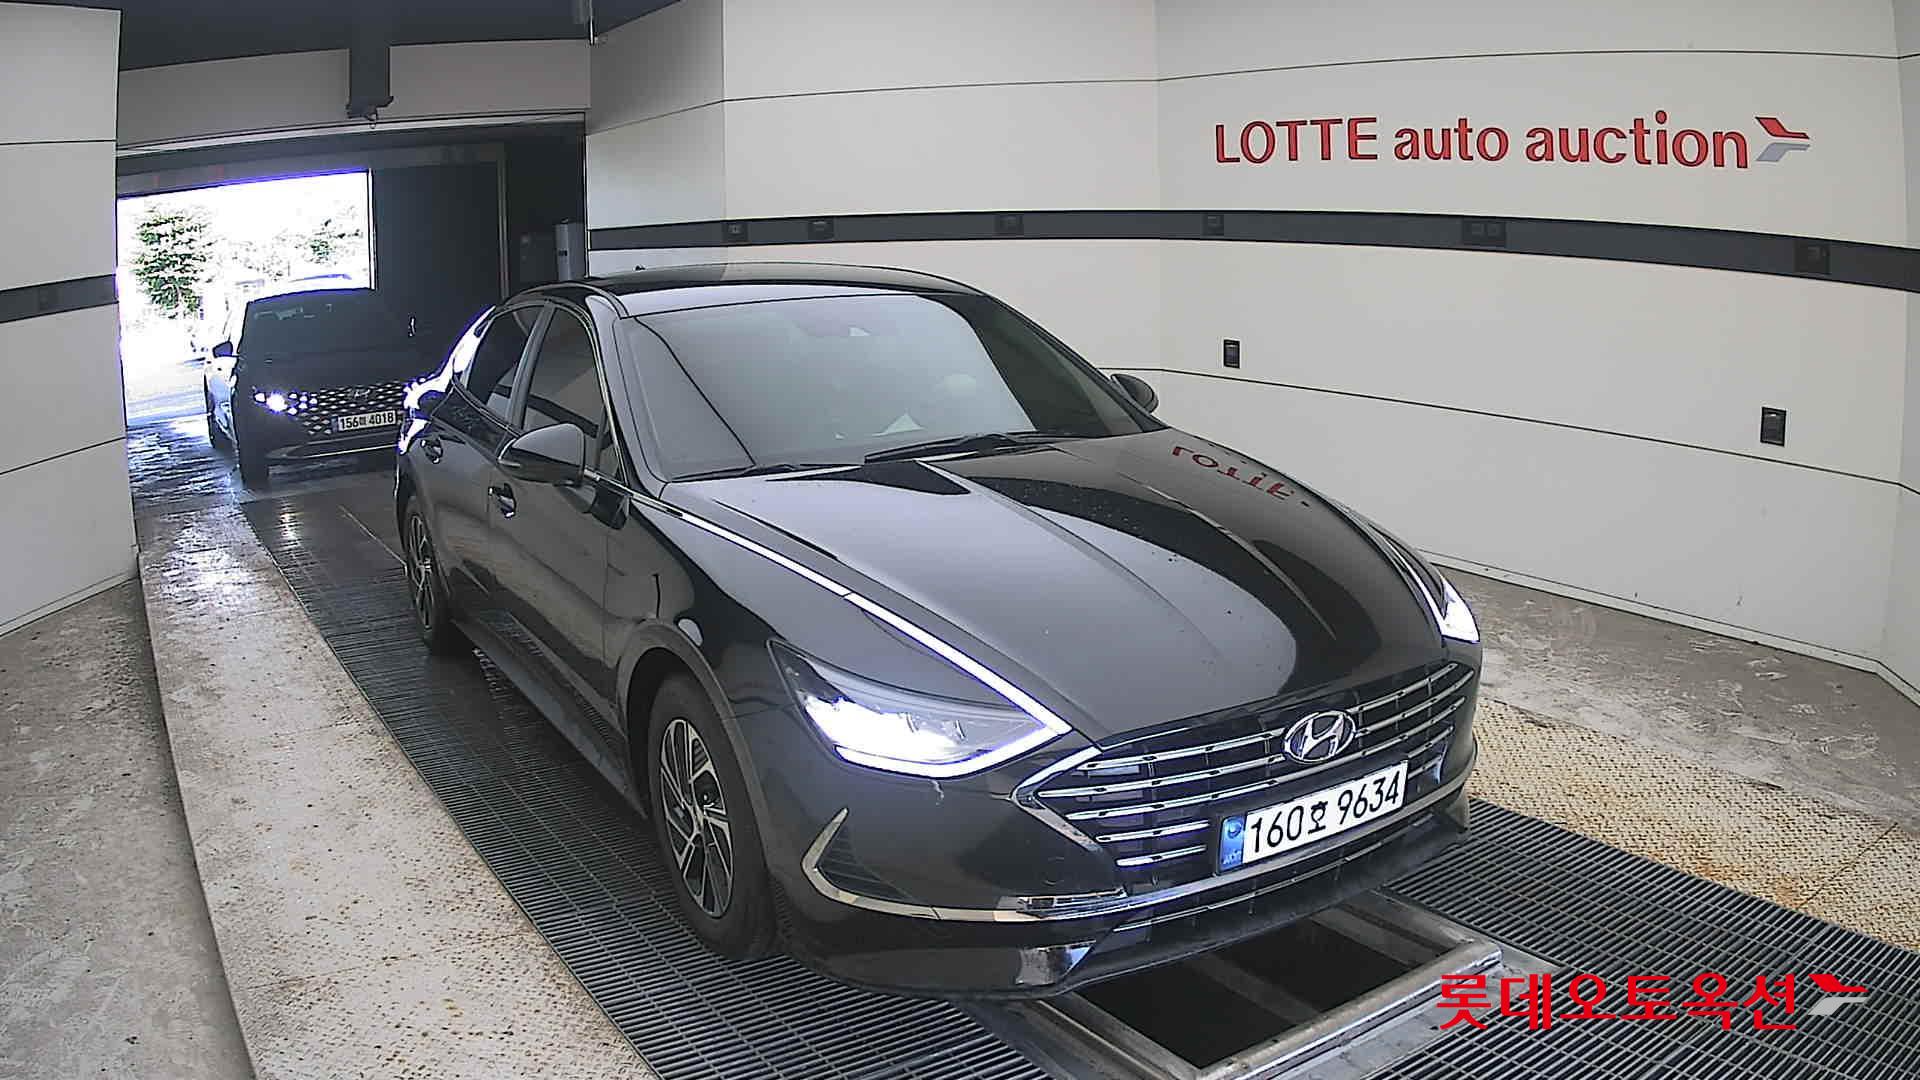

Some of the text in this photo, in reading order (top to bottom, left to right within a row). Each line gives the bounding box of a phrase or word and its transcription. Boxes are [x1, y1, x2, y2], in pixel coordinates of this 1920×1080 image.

[1215, 110, 1749, 168] LOTTE auto auction
[369, 412, 394, 424] 4018
[1250, 770, 1401, 853] 160호 9634
